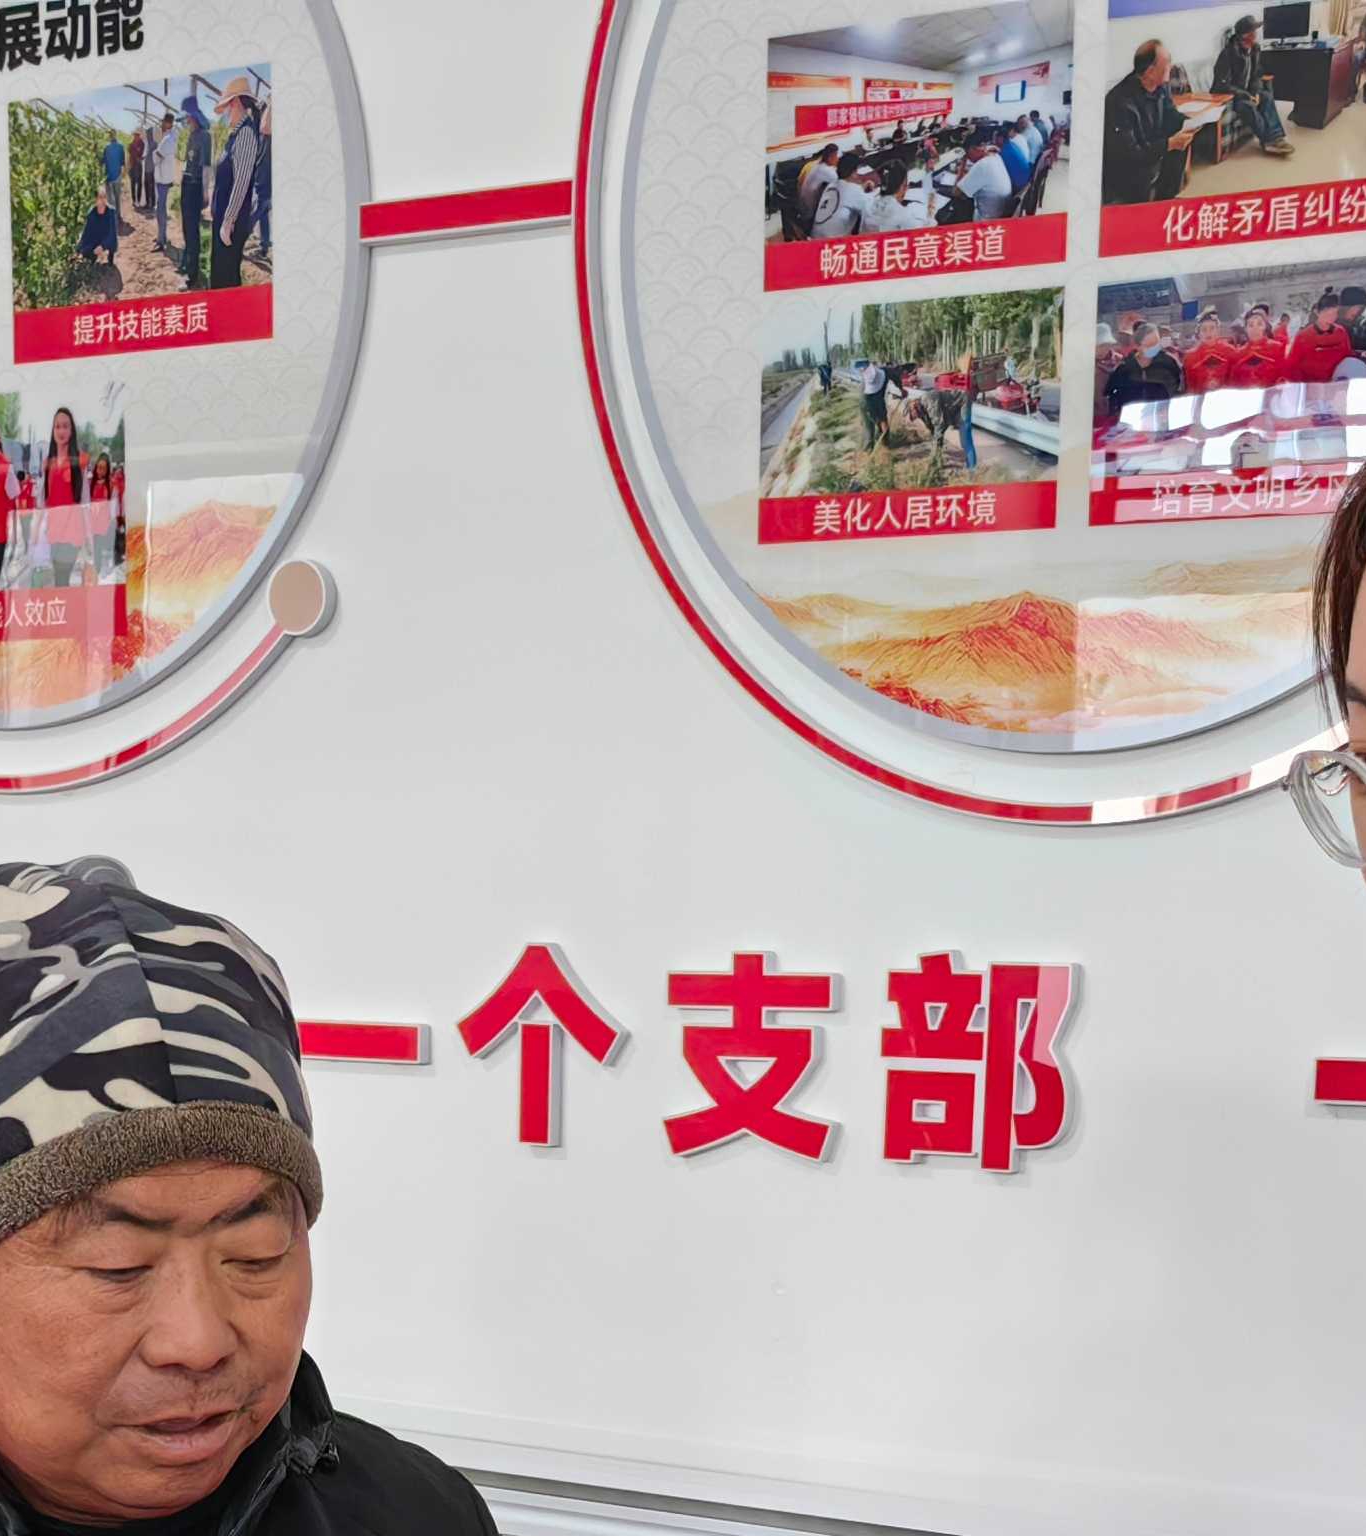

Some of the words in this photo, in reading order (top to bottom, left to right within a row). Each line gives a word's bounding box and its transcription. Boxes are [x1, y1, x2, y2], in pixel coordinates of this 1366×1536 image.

[819, 226, 1005, 277] 畅通民意渠道
[73, 309, 208, 346] 提升技能素质
[812, 491, 997, 535] 美化人居环境
[298, 940, 1077, 1174] 一个支部
